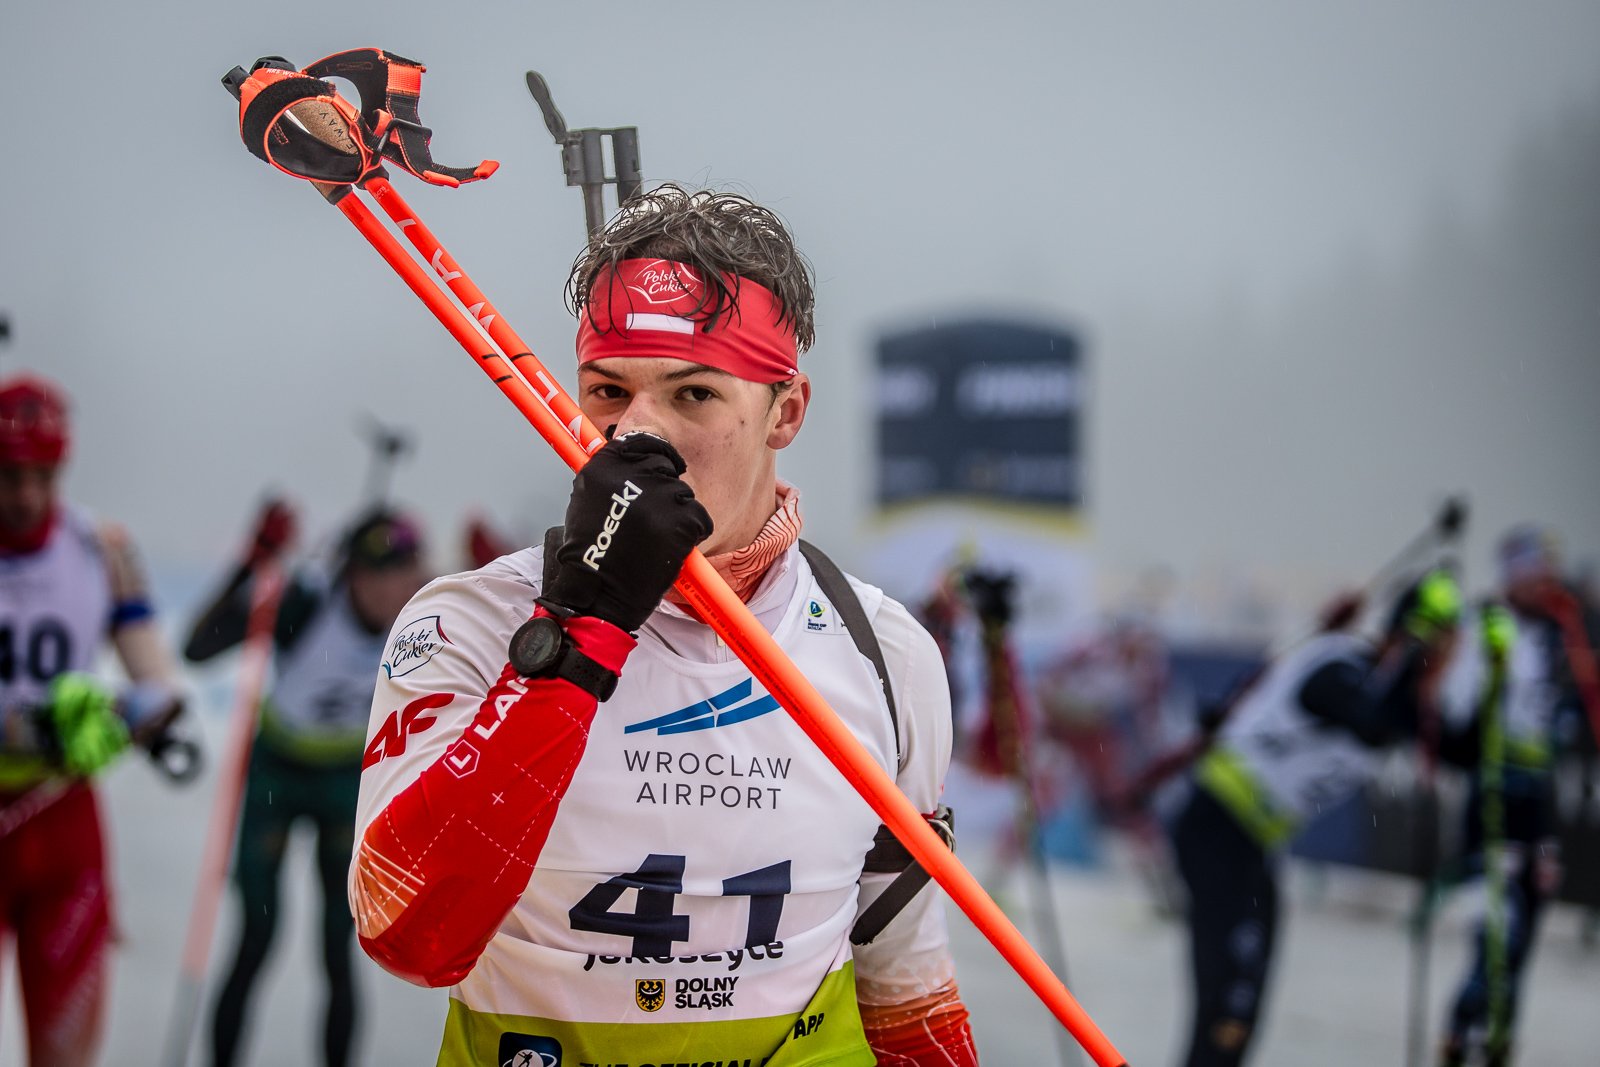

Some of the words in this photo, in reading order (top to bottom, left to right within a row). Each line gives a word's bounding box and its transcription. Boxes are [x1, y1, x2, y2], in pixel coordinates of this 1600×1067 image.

[642, 269, 682, 286] Polski
[648, 281, 692, 295] Cukier
[582, 479, 644, 571] Roeckl
[391, 629, 434, 658] Polski
[393, 642, 438, 668] Cukier
[624, 749, 792, 780] WROCLAW
[636, 781, 782, 810] AIRPORT
[568, 853, 793, 958] 41
[675, 976, 739, 994] DOLNY
[675, 990, 734, 1011] ŚLĄSK
[792, 1013, 825, 1040] APP
